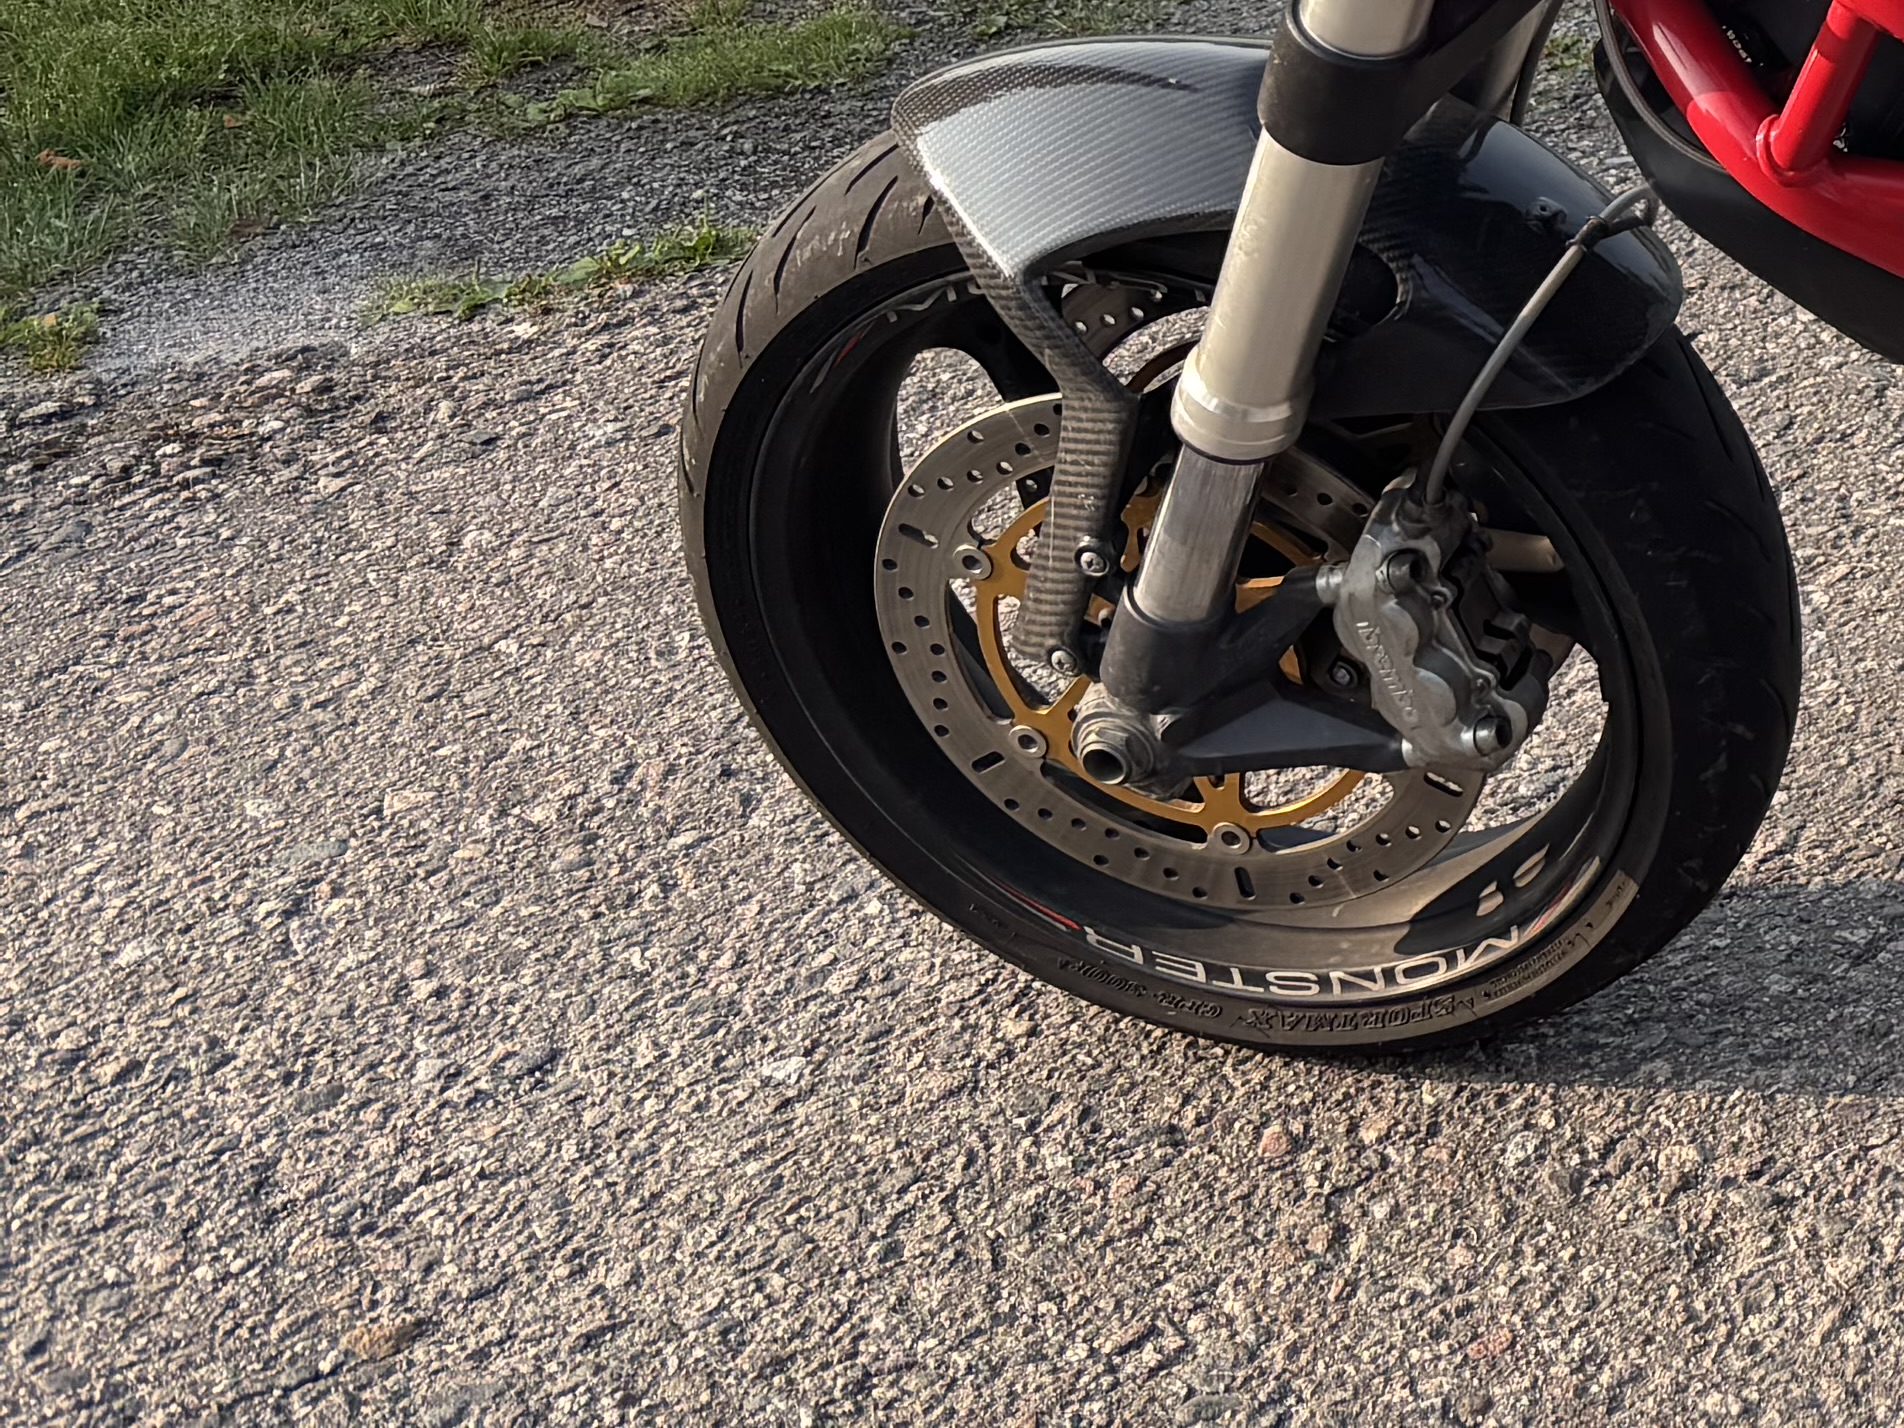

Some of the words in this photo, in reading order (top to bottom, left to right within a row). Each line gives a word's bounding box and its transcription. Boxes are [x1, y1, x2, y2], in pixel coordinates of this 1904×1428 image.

[1356, 621, 1419, 724] brembo
[1083, 924, 1519, 997] MONSTER
[1242, 993, 1457, 1032] SPORTMAX
